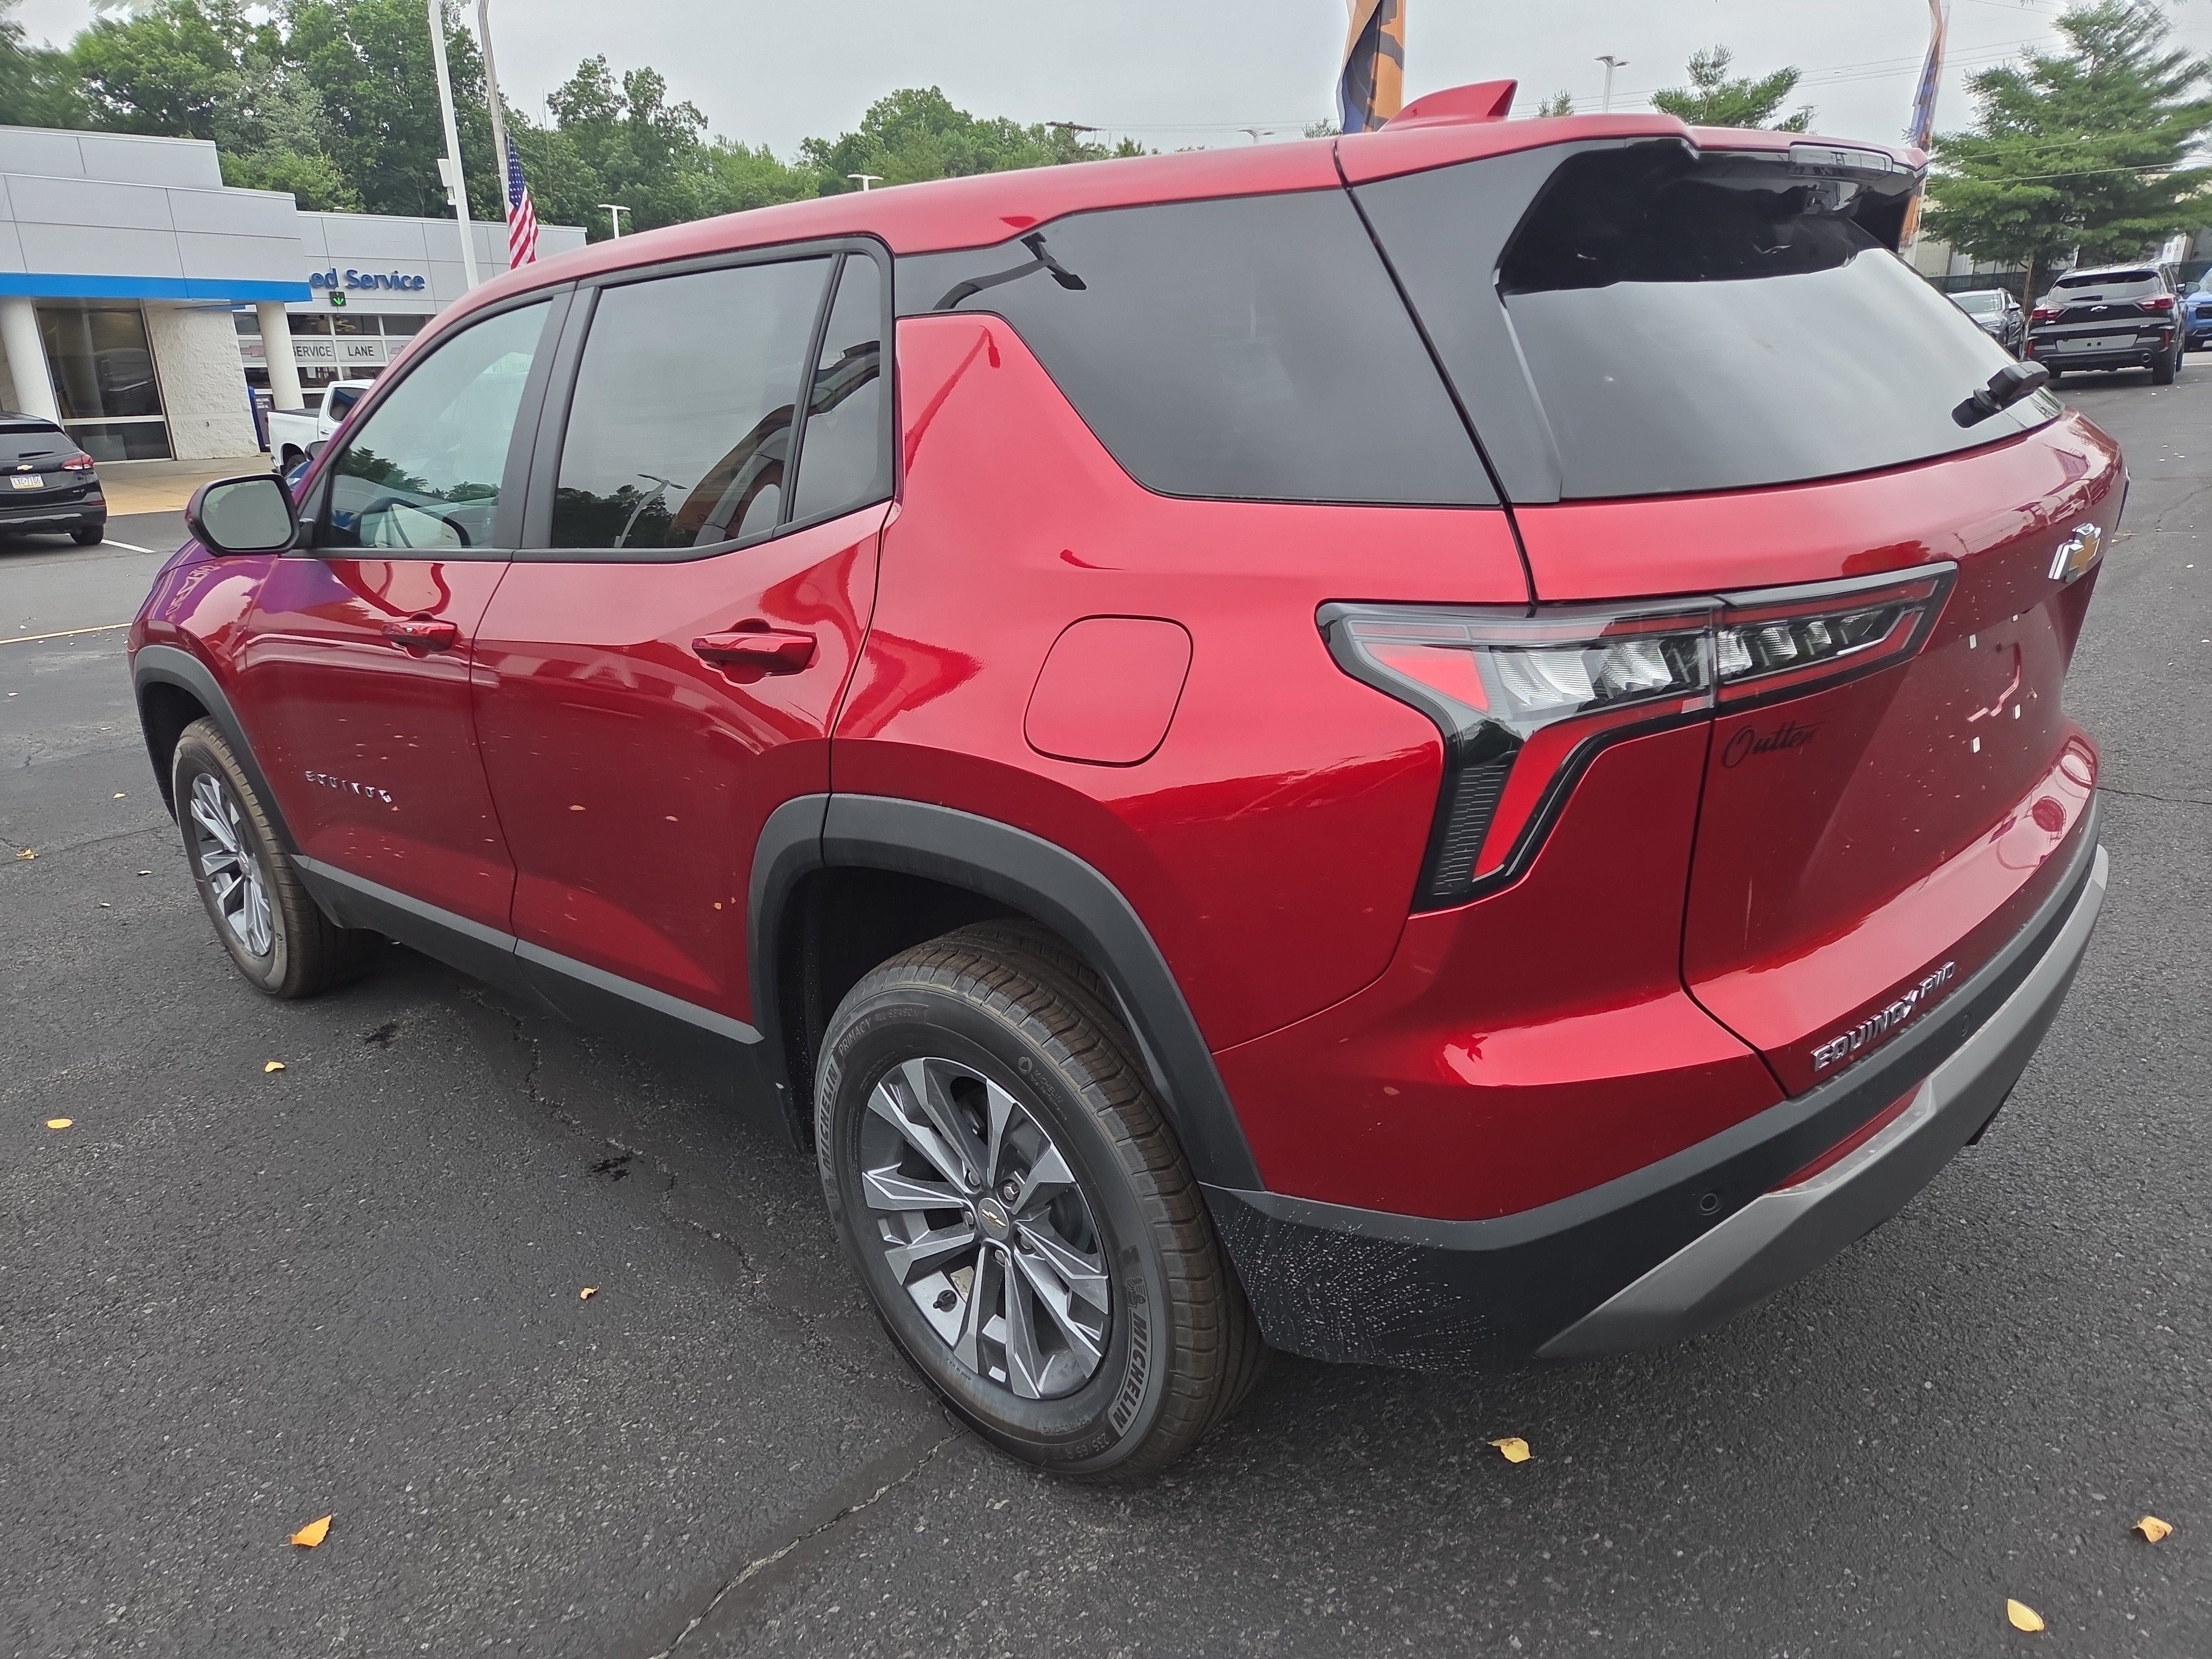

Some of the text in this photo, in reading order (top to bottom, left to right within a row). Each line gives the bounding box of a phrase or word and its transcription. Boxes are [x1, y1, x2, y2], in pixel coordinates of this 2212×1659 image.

[345, 269, 425, 291] Service
[348, 345, 375, 356] LANE
[838, 1017, 871, 1058] PRIMACY
[1810, 989, 1919, 1072] EQUINOX
[819, 1063, 839, 1172] MICHELIN
[1112, 1313, 1147, 1430] MICHELIN
